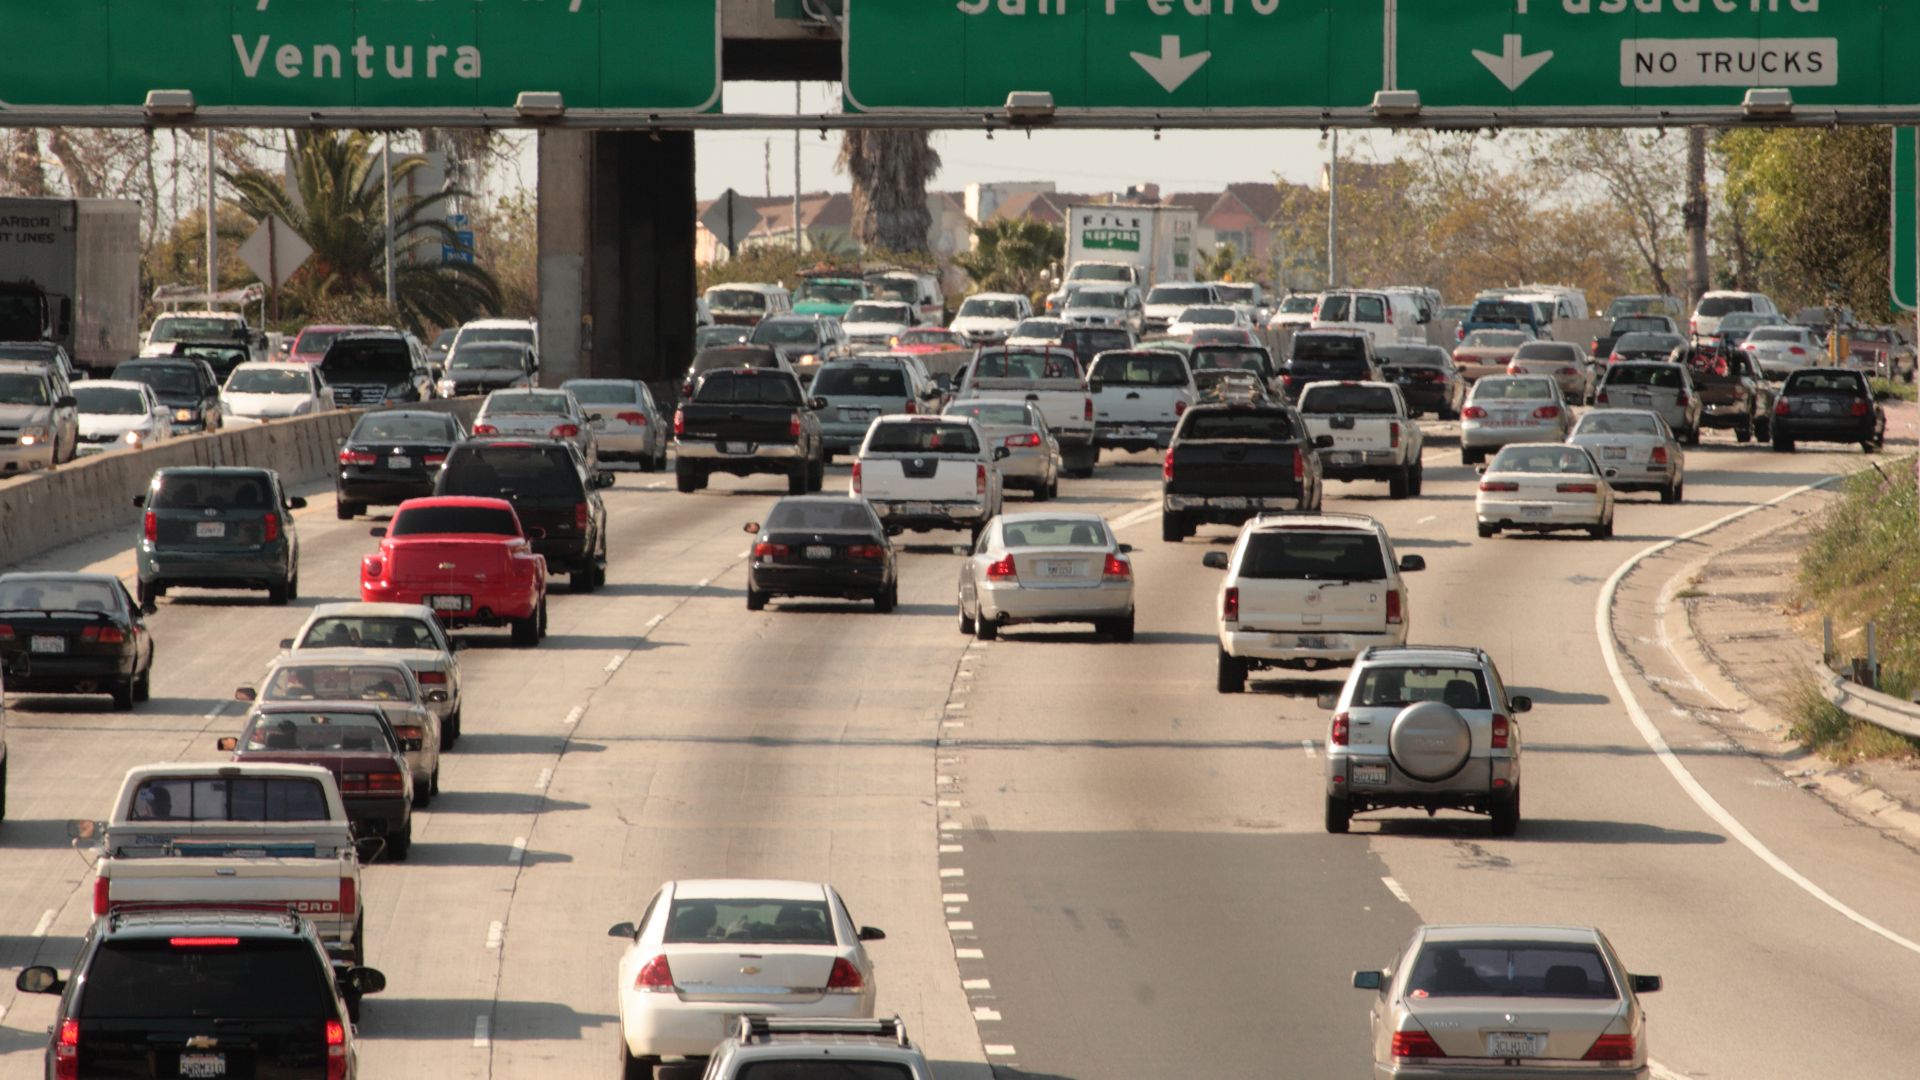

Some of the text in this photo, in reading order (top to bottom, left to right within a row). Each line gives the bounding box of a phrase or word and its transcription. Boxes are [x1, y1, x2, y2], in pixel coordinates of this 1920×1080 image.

[231, 34, 482, 78] Ventura
[1635, 51, 1823, 73] NO TRUCKS
[1083, 217, 1139, 228] FILE
[16, 233, 55, 243] LINES
[1085, 230, 1138, 241] KEEPERS
